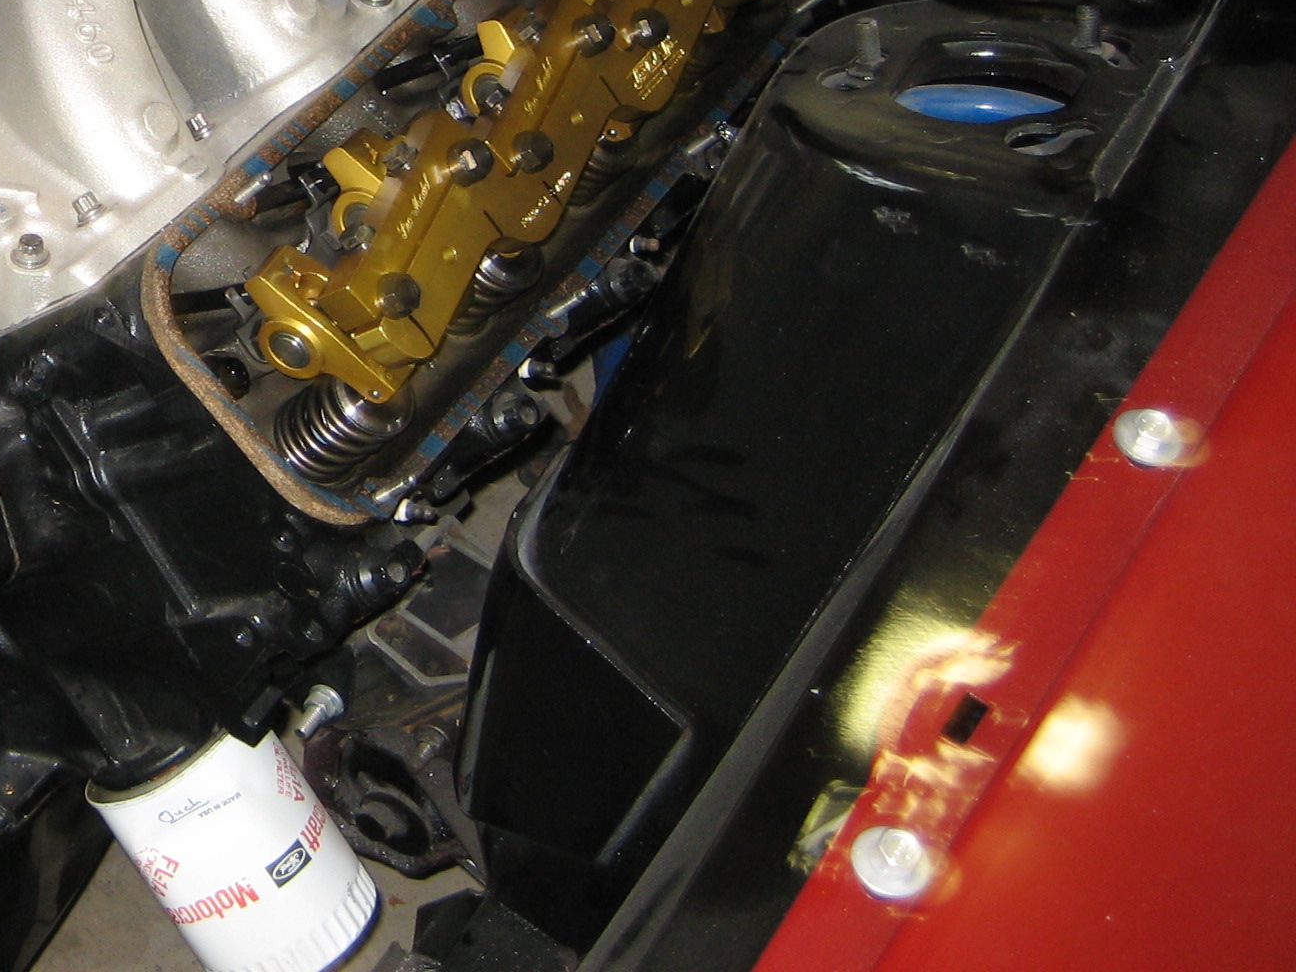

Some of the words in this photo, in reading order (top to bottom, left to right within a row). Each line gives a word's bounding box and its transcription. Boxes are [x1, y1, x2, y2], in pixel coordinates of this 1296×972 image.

[223, 791, 242, 807] MADE
[212, 802, 222, 810] IN
[198, 807, 214, 818] USA
